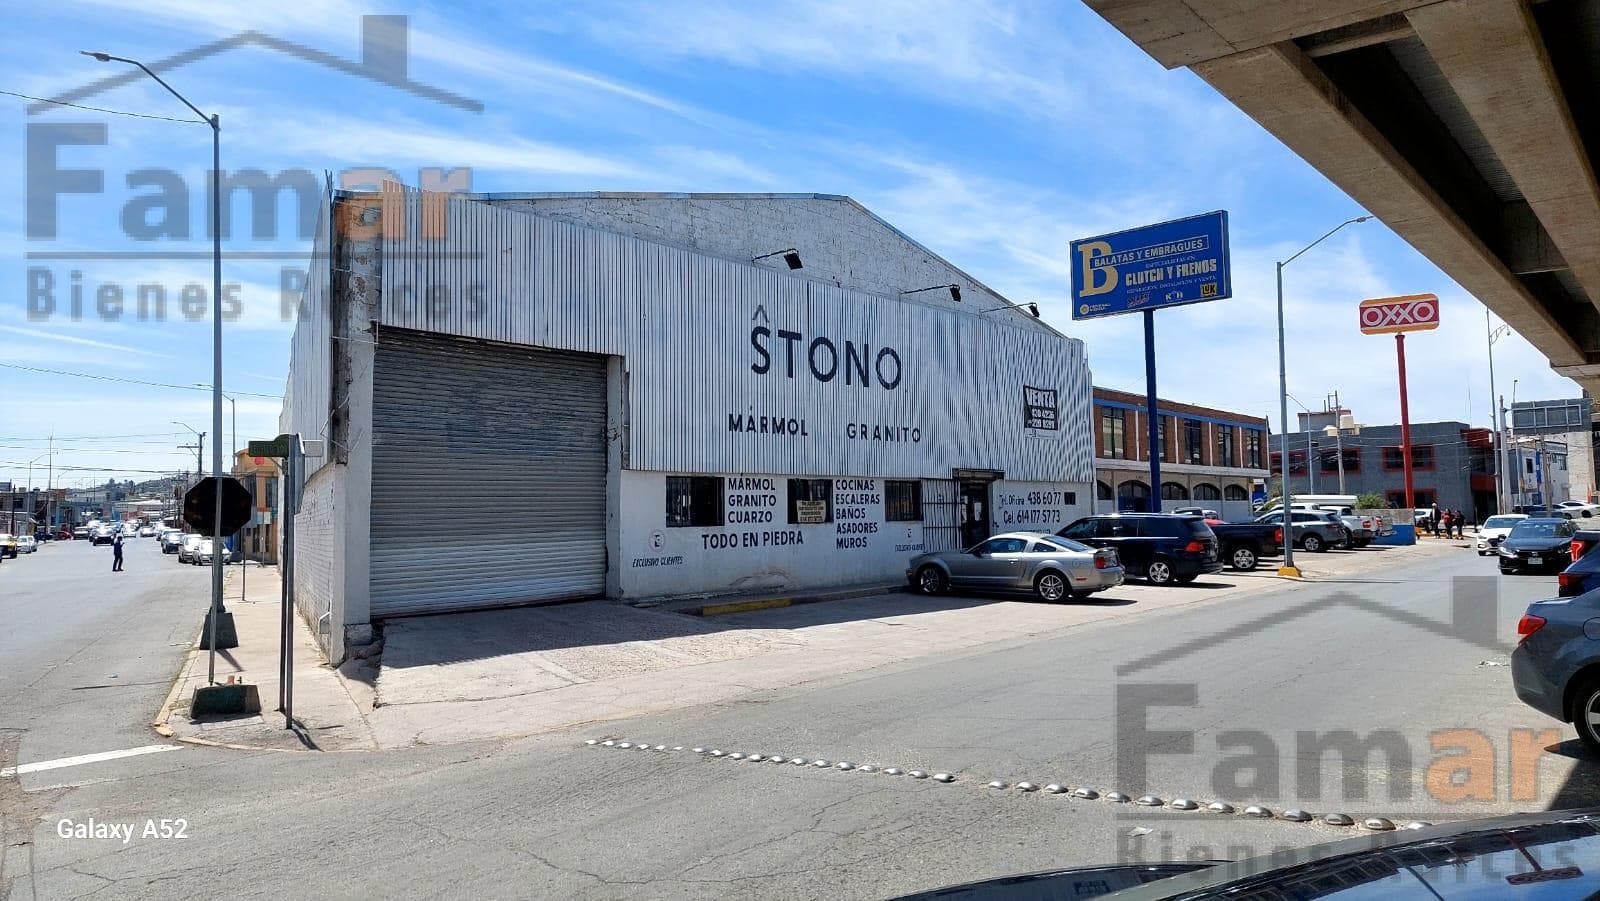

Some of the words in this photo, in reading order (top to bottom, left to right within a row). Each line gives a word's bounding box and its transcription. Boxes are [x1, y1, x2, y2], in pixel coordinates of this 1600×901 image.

[1094, 251, 1135, 267] BALATAS
[1137, 250, 1143, 259] Y
[1144, 239, 1203, 258] EMBRAGUES
[1125, 267, 1163, 286] CLUTCH
[1166, 265, 1173, 279] Y
[1176, 258, 1217, 278] FRENOS
[1362, 301, 1435, 327] OXXO
[1025, 388, 1055, 408] VENTA
[847, 422, 921, 443] GRANITO
[836, 479, 875, 491] COCINAS
[728, 495, 777, 507] GRANITO
[836, 494, 880, 505] ESCALERAS
[728, 511, 773, 524] CUARZO
[836, 506, 866, 520] BAÑOS
[837, 522, 879, 535] ASADORES
[702, 533, 738, 550] TODO
[743, 532, 758, 548] EN
[763, 530, 804, 547] PIEDRA
[836, 536, 869, 550] MUROS
